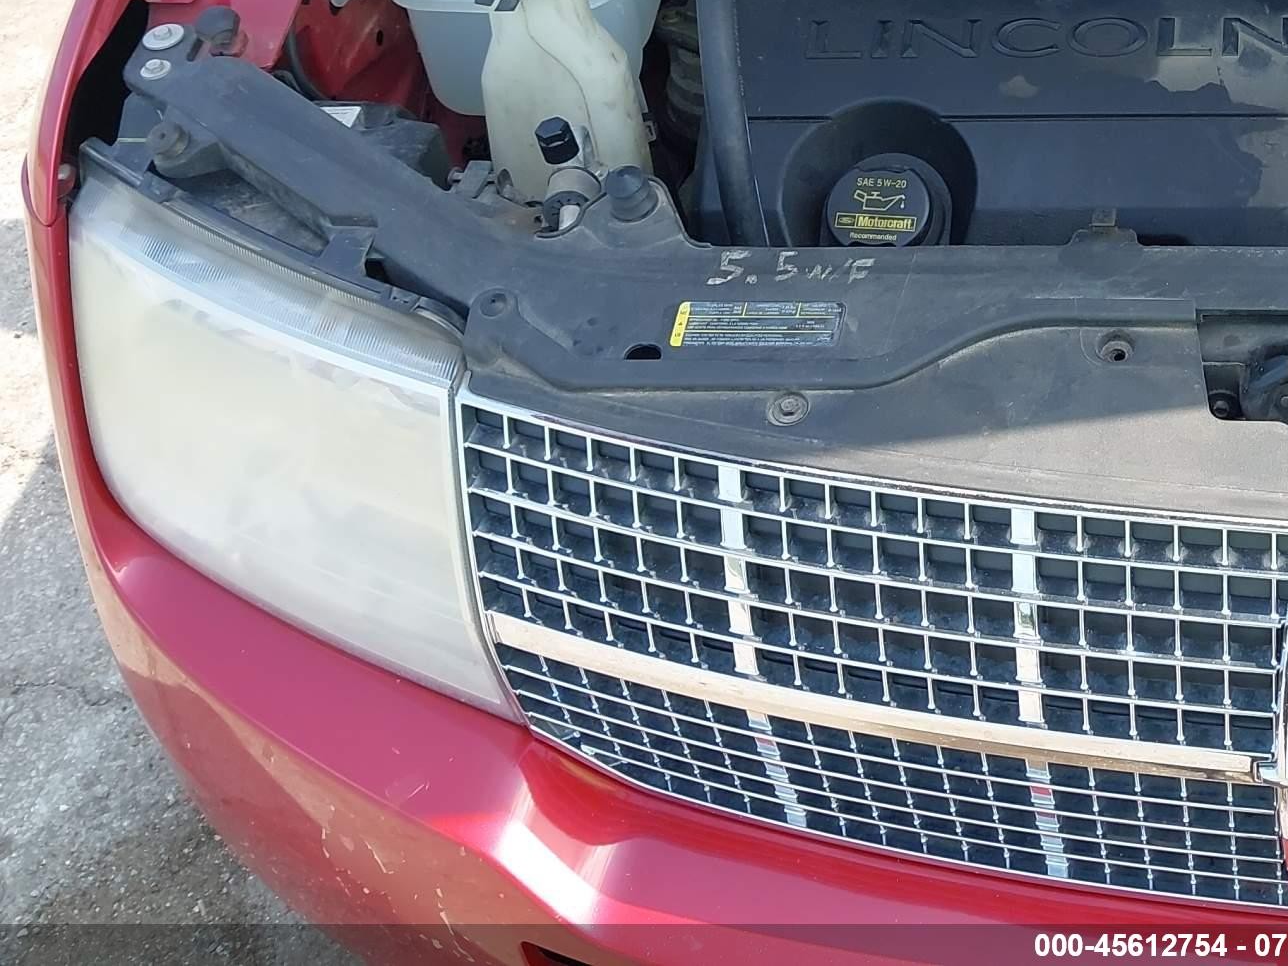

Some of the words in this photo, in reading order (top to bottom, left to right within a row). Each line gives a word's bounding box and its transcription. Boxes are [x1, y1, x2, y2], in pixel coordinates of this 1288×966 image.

[857, 177, 875, 187] SAE
[858, 216, 912, 229] Motorcraft
[849, 232, 897, 241] Recommended
